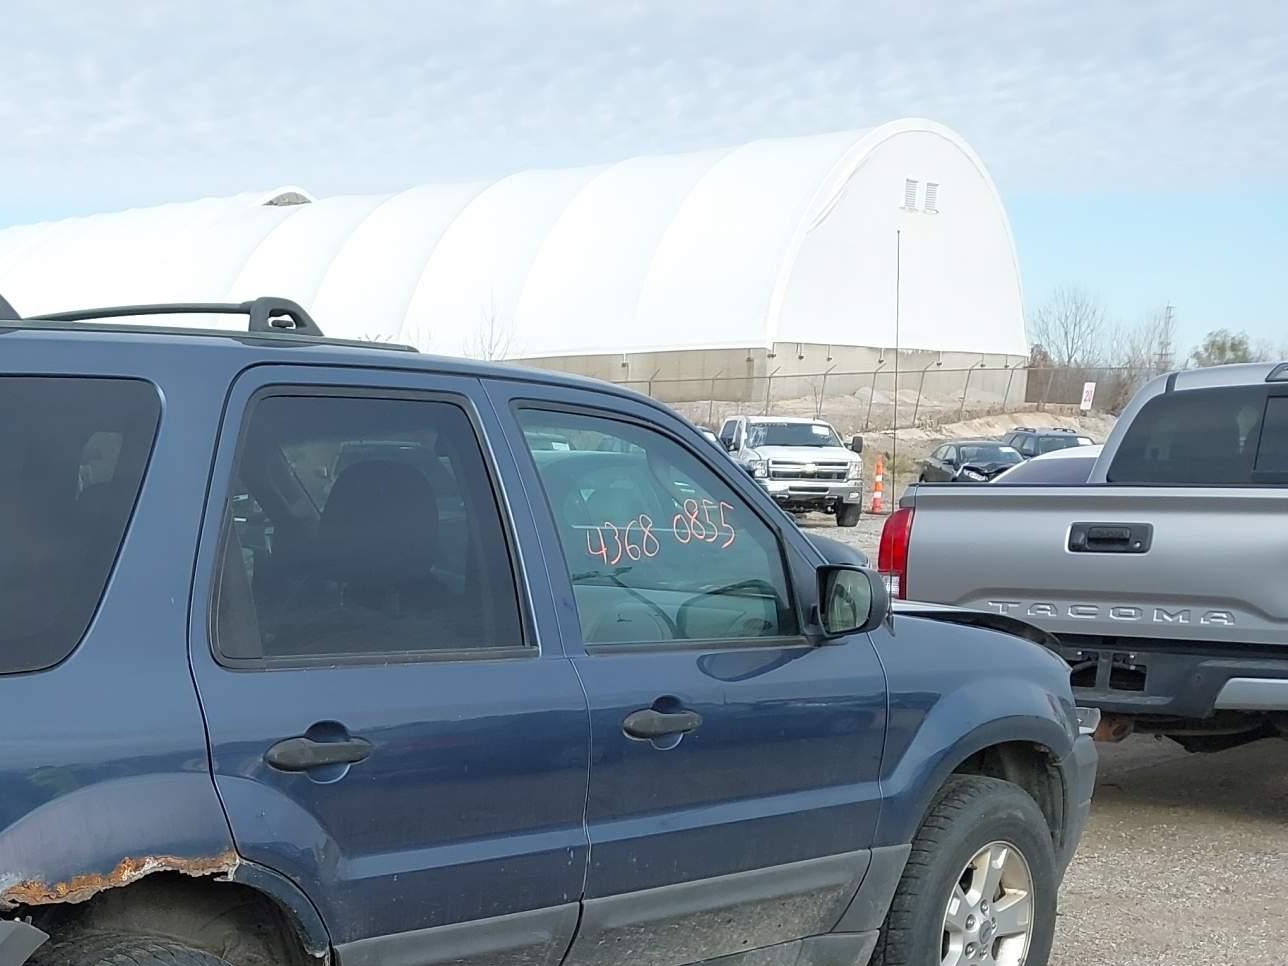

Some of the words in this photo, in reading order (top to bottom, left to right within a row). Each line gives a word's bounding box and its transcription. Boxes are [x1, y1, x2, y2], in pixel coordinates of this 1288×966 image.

[586, 513, 660, 565] 4368
[673, 498, 735, 549] 0855
[988, 601, 1236, 626] TACOMA
